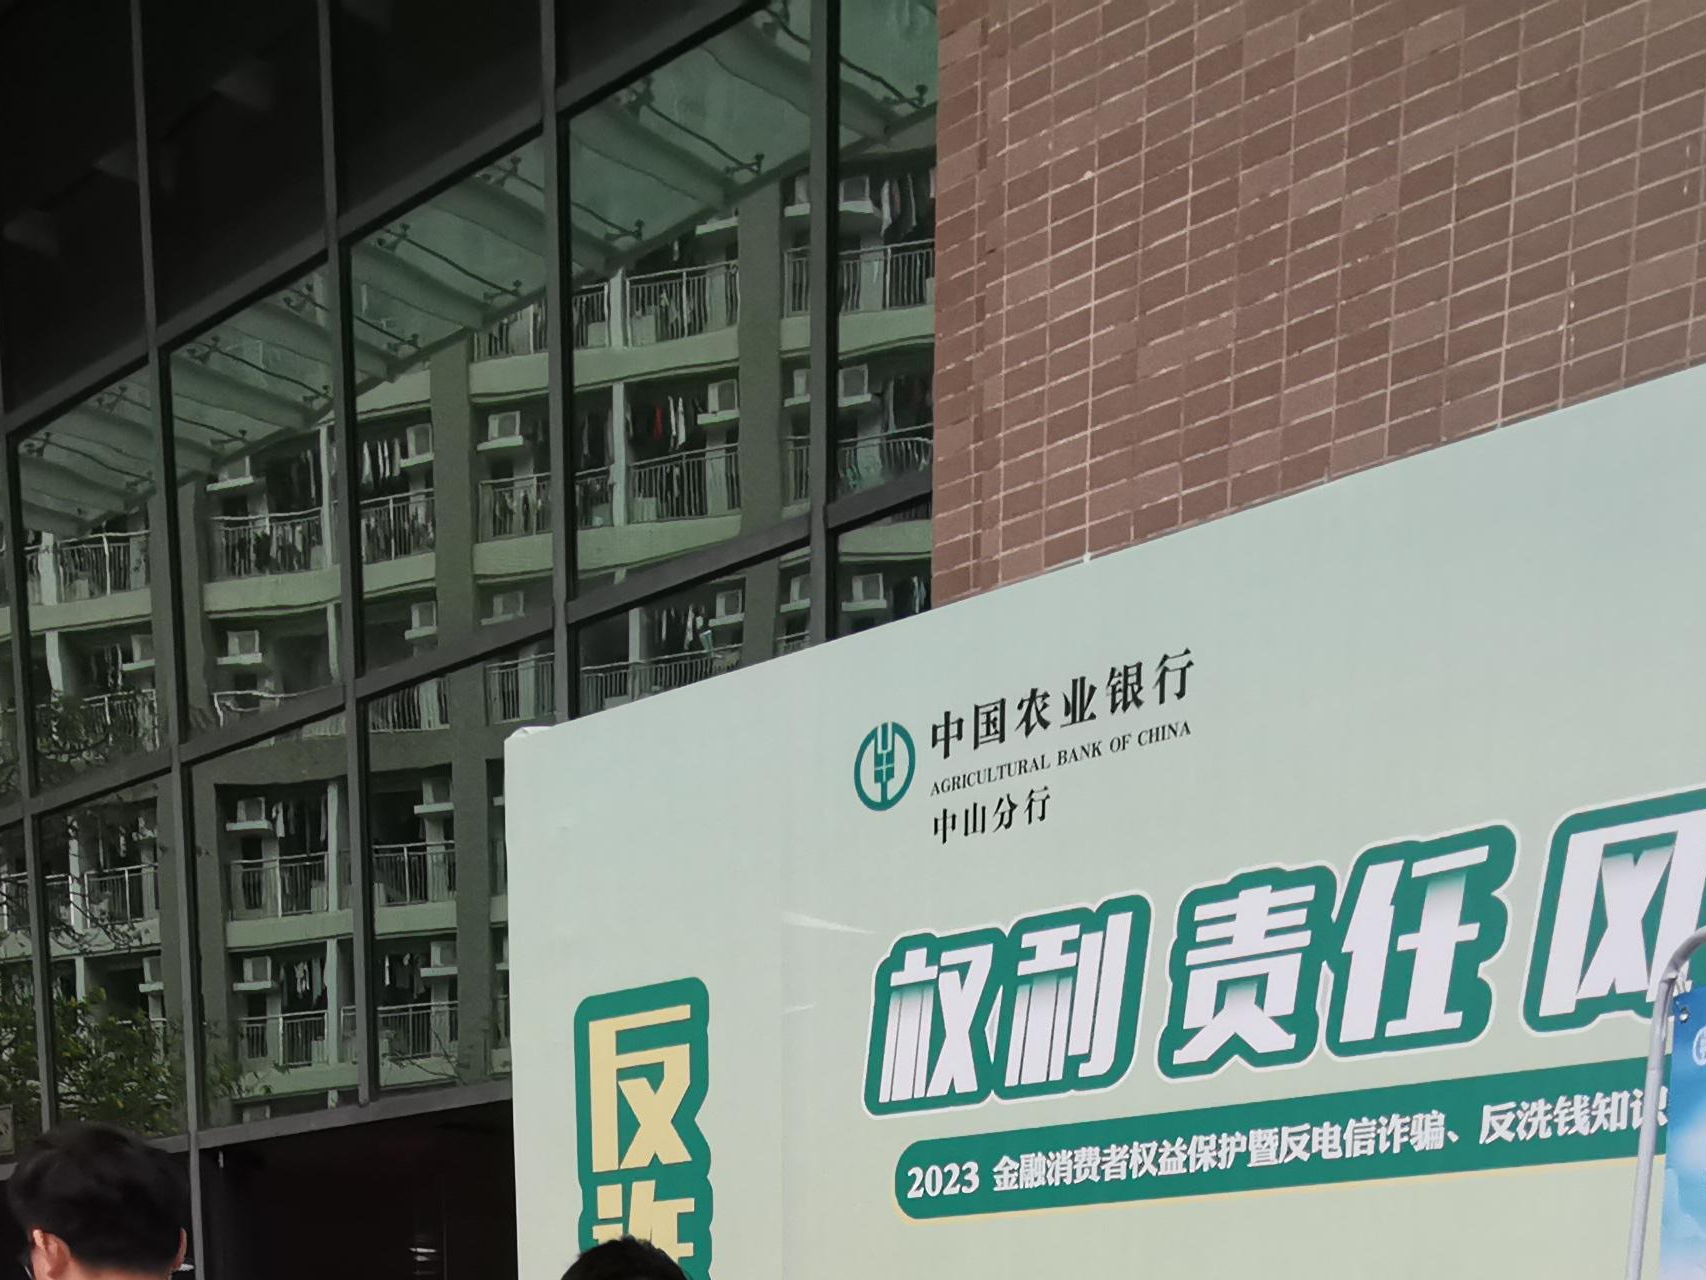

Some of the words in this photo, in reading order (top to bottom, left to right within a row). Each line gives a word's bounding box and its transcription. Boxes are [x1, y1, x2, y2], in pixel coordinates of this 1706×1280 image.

[930, 648, 1195, 760] 中国农业银行
[929, 754, 1051, 797] AGRICULTURAL
[1057, 740, 1103, 767] BANK
[1109, 733, 1132, 754] OF
[1137, 719, 1192, 747] CHINA
[932, 785, 1051, 845] 中山分行
[876, 911, 1136, 1105] 权利
[1172, 846, 1491, 1062] 责任
[905, 1162, 980, 1200] 2023
